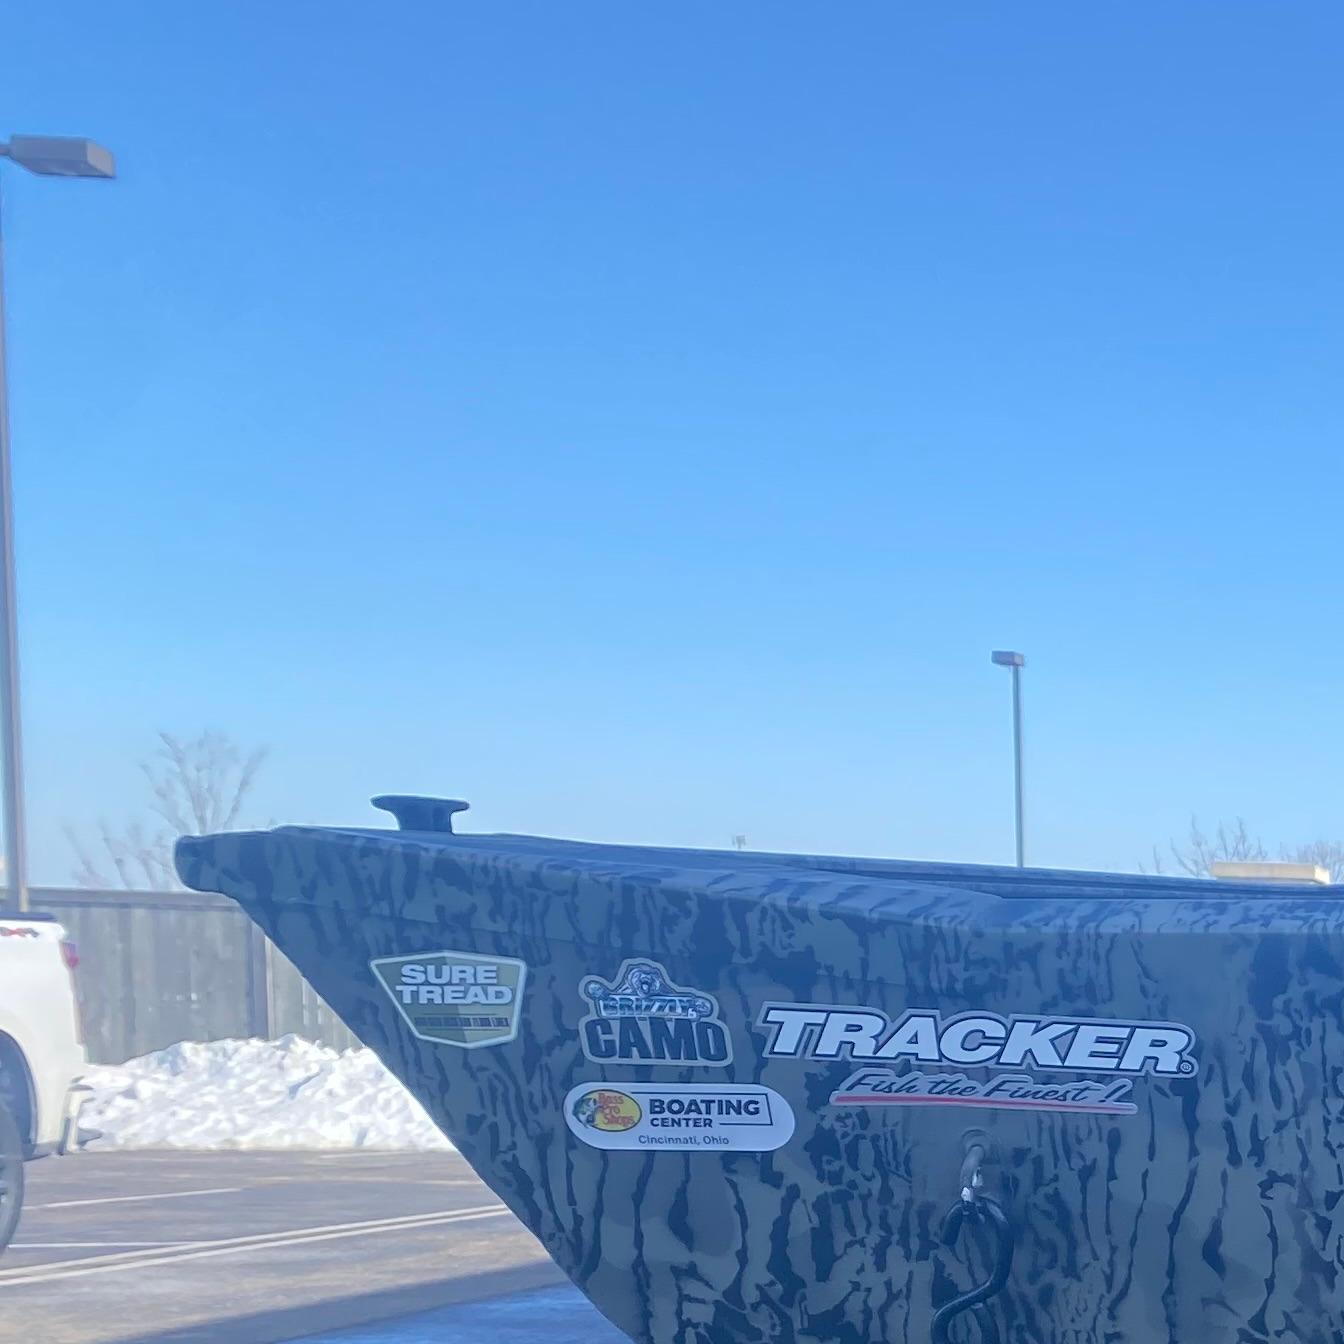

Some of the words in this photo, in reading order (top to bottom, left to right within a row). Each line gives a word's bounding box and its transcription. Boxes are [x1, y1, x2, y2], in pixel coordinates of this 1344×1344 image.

[400, 964, 497, 984] SURE
[395, 985, 513, 1005] TREAD
[603, 997, 691, 1017] GRIZZLY
[584, 1016, 728, 1062] CAMO
[763, 1007, 1195, 1074] TRACKER
[846, 1074, 920, 1095] Fish
[926, 1077, 978, 1098] the
[597, 1092, 625, 1105] Bass
[648, 1098, 761, 1116] BOATING
[602, 1113, 636, 1128] Shops
[650, 1117, 713, 1128] CENTER
[638, 1134, 701, 1147] Cincinnati,
[702, 1134, 730, 1145] Ohio
